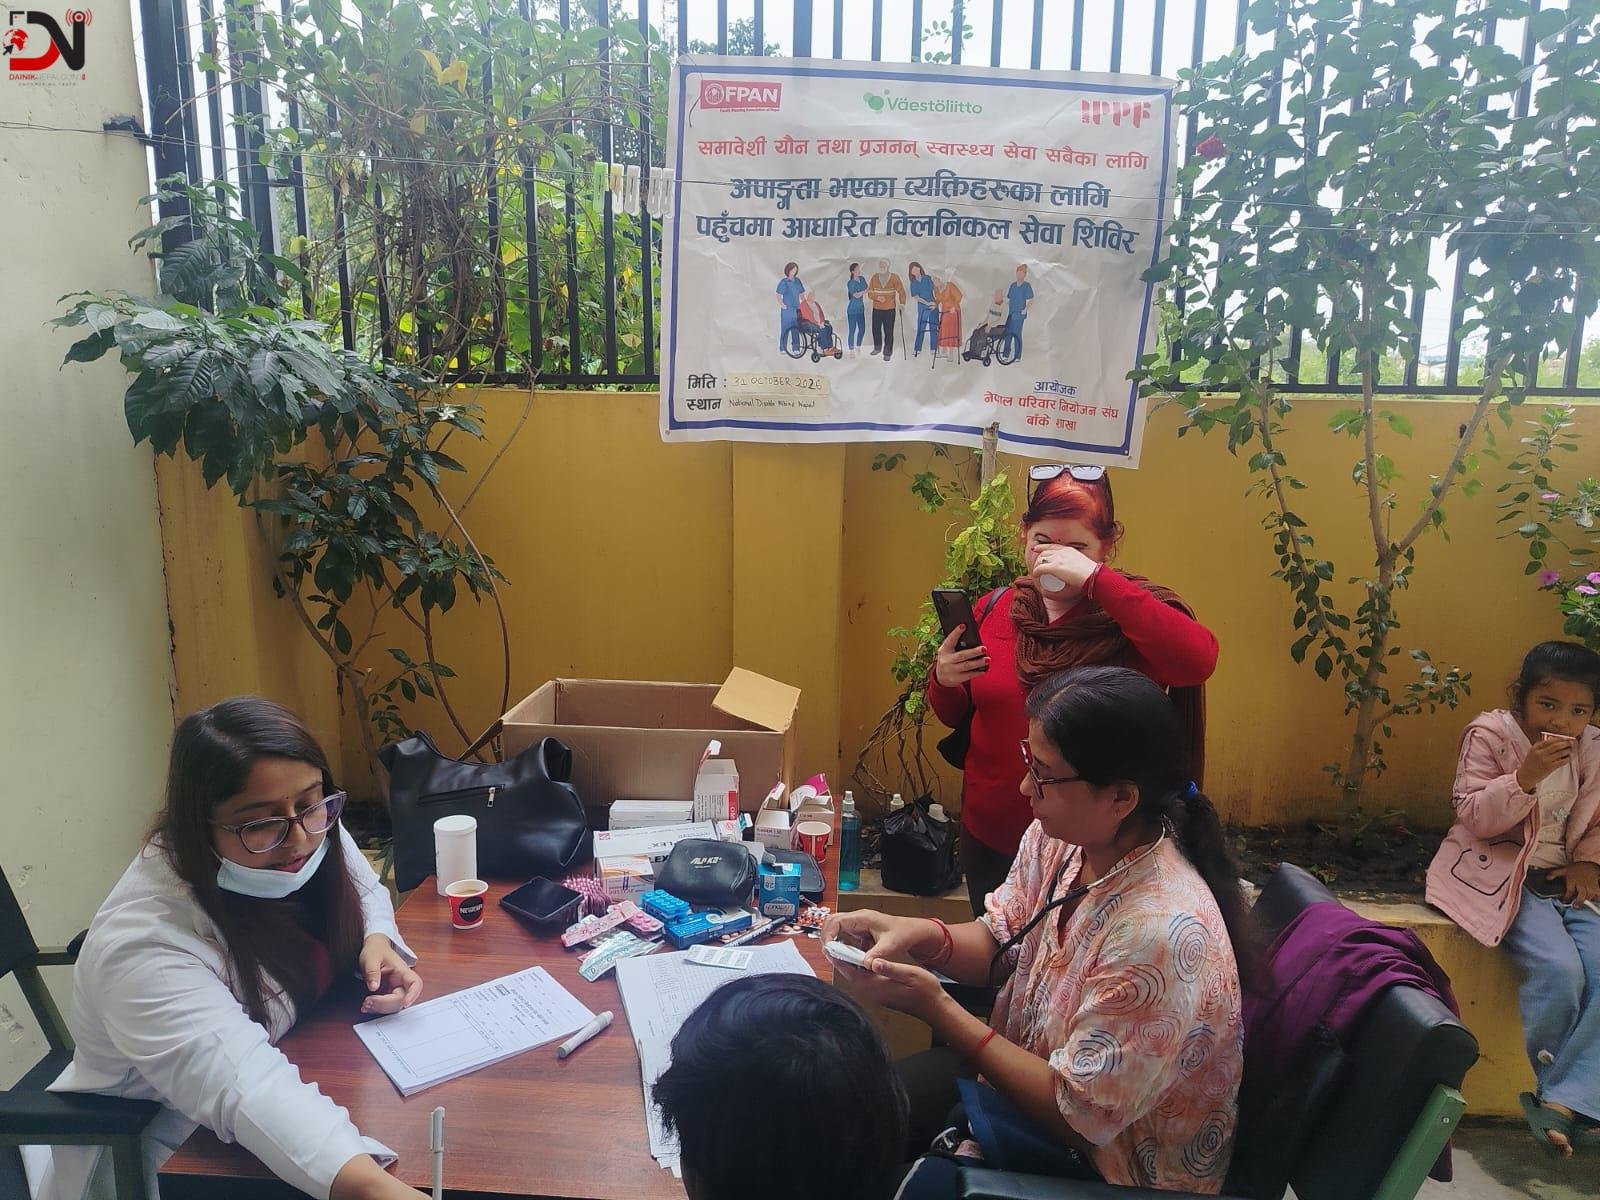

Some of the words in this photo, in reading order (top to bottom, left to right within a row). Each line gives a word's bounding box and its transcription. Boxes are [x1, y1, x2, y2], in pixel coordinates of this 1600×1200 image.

[725, 86, 778, 103] FPAN
[887, 97, 983, 114] Väestöliitto
[1081, 100, 1151, 128] IPPF
[698, 135, 767, 156] समावेशी
[774, 135, 810, 155] यौन
[817, 139, 852, 155] तथा
[926, 141, 995, 158] स्वास्थ्य
[1003, 141, 1039, 161] सेवा
[1045, 145, 1098, 167] सबैका
[1105, 152, 1150, 170] लागि
[829, 177, 898, 199] भएका
[1050, 181, 1111, 208] लागि
[696, 210, 775, 243] पहुँचमा
[782, 210, 879, 238] आधारित
[886, 208, 1012, 240] क्लिनिकल
[1019, 214, 1065, 245] सेवा
[1072, 217, 1140, 254] शिविर
[687, 373, 717, 389] मिति
[1034, 380, 1077, 396] आयोजक
[686, 398, 722, 411] स्थान
[984, 391, 1013, 407] नेपाल
[1019, 395, 1057, 410] परिवार
[1059, 399, 1097, 417] नियोजन
[1101, 406, 1120, 419] संघ
[1055, 418, 1077, 431] शाखा
